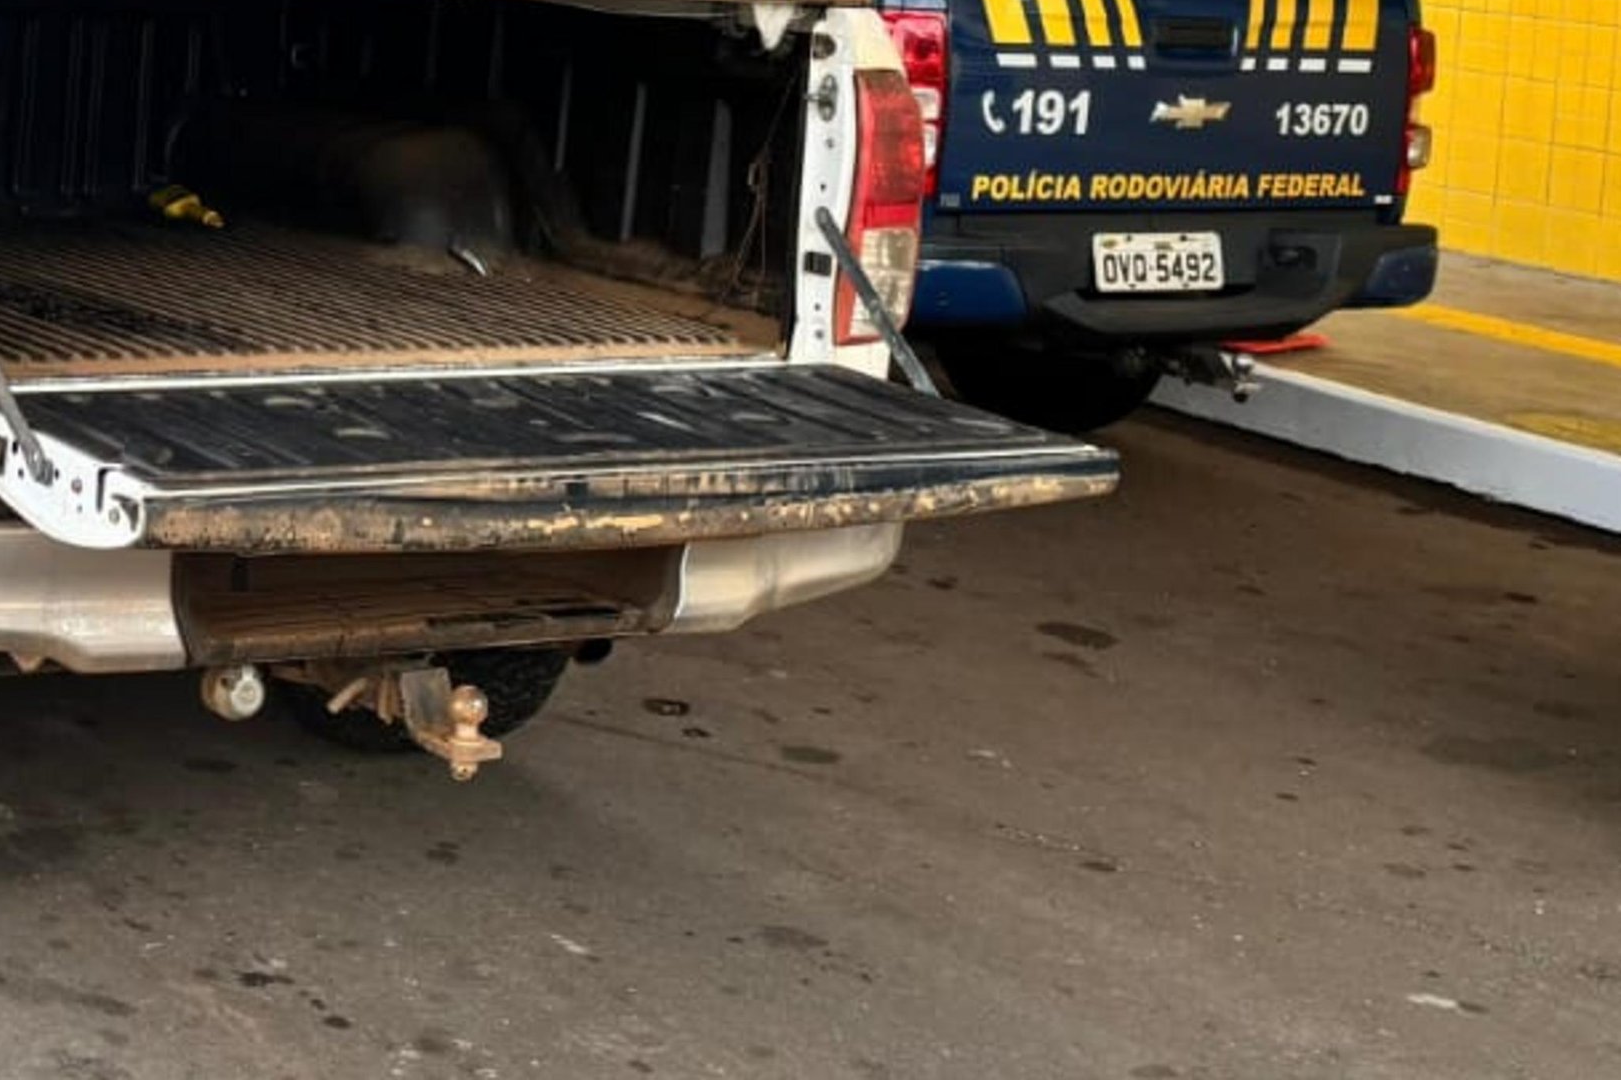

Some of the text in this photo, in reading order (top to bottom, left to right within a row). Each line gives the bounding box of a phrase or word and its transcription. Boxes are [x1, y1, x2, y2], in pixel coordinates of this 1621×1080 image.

[1011, 89, 1091, 134] 191
[1276, 102, 1369, 136] 13670
[971, 169, 1082, 201] POLÍCIA
[1090, 169, 1249, 200] RODOVIÁRIA
[1257, 173, 1366, 197] FEDERAL
